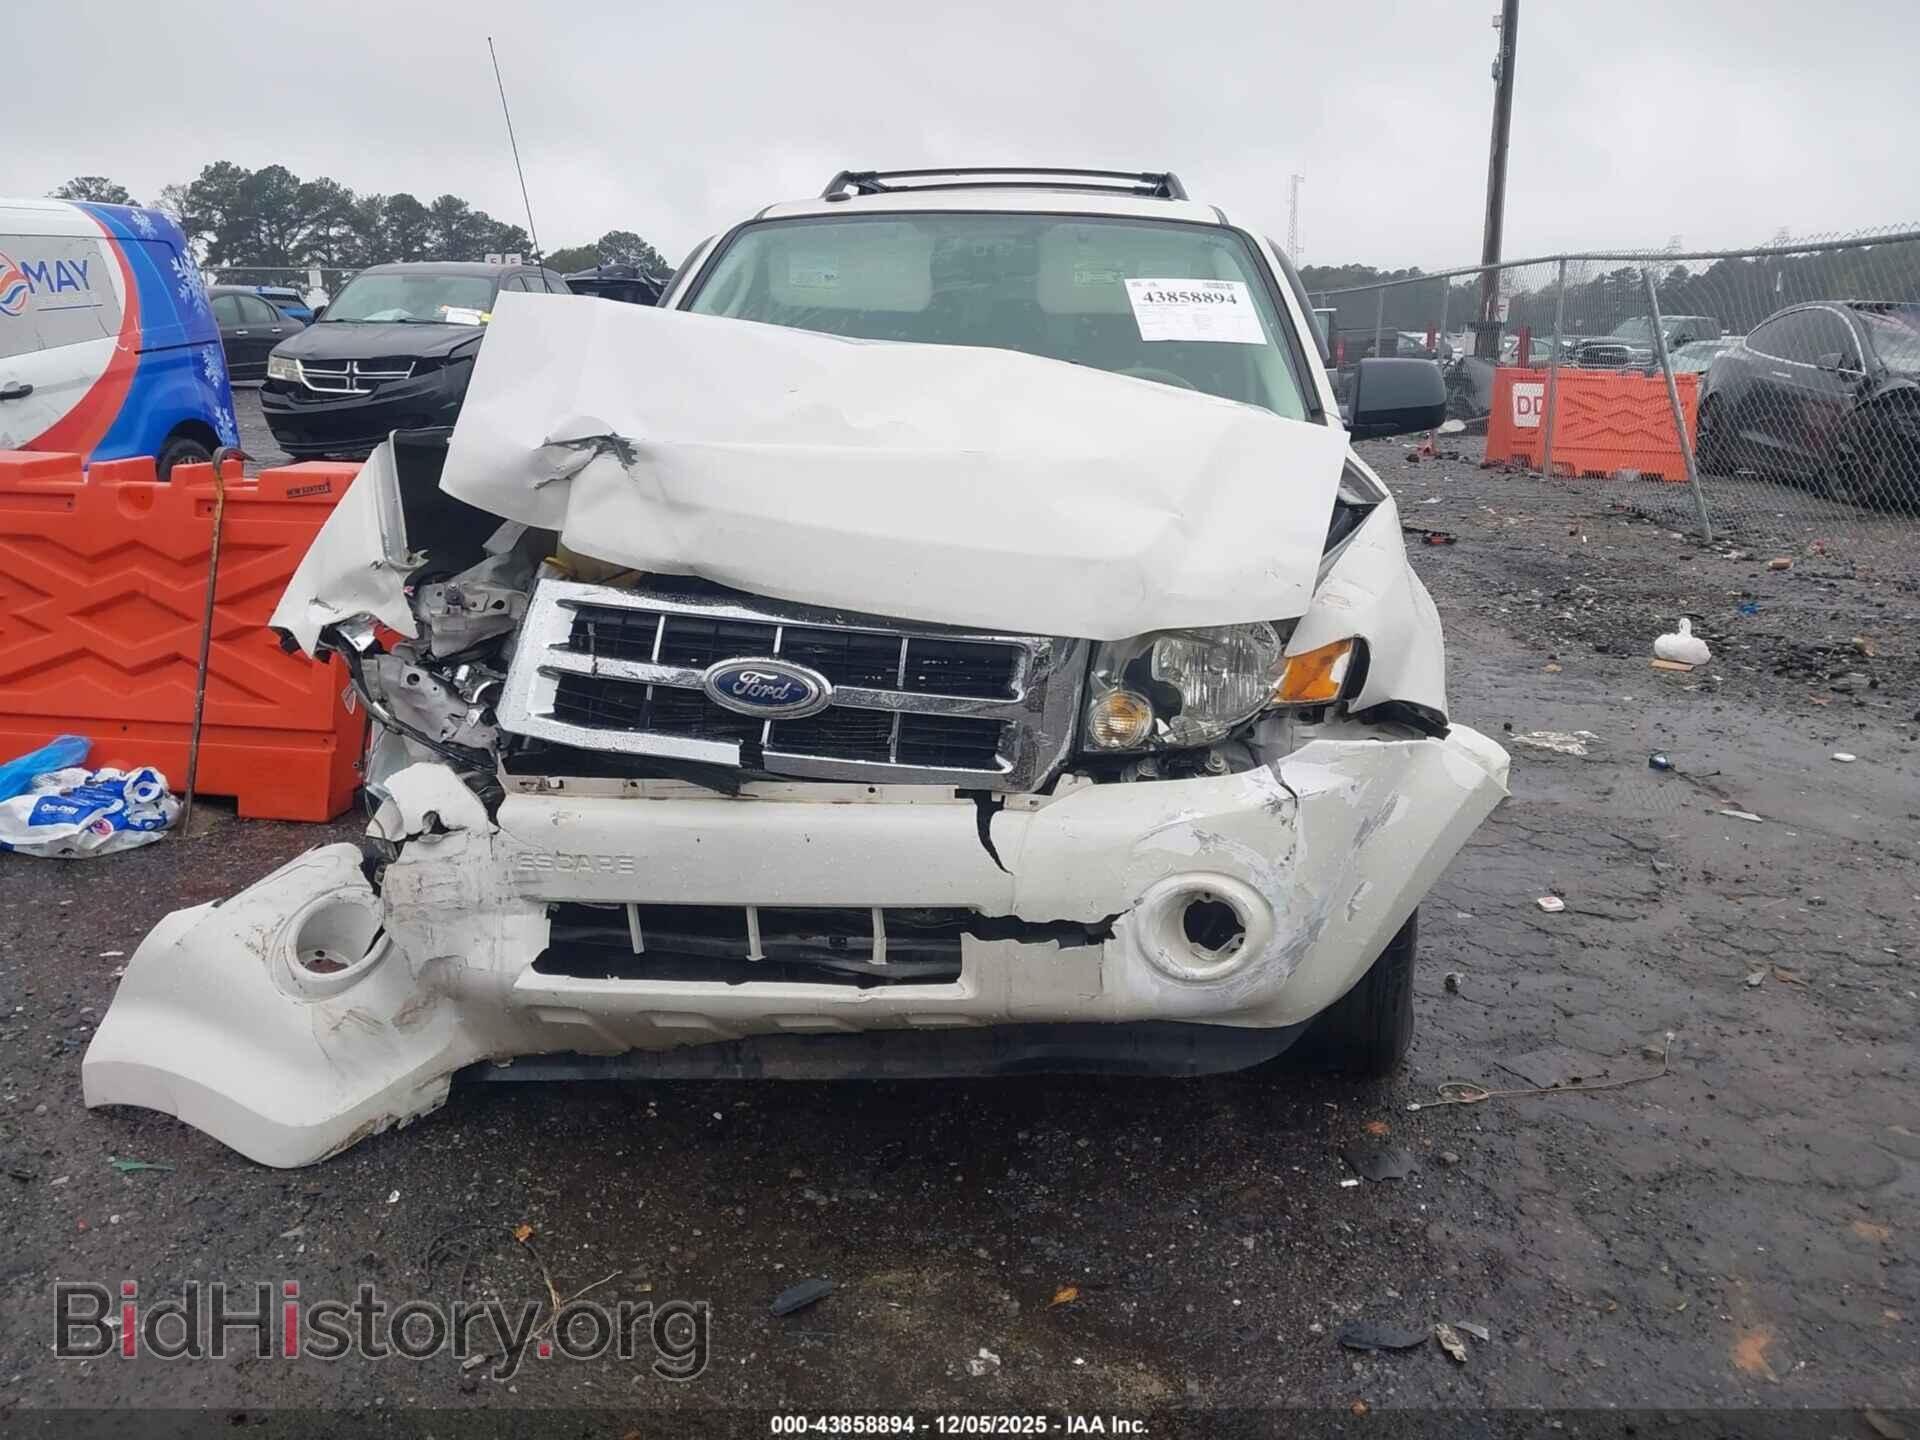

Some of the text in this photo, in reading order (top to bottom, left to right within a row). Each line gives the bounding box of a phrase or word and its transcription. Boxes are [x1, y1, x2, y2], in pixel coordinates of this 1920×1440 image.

[20, 259, 91, 294] MAY
[1142, 291, 1238, 305] 43858894
[732, 671, 792, 699] Ford
[516, 852, 636, 874] ESCAPE
